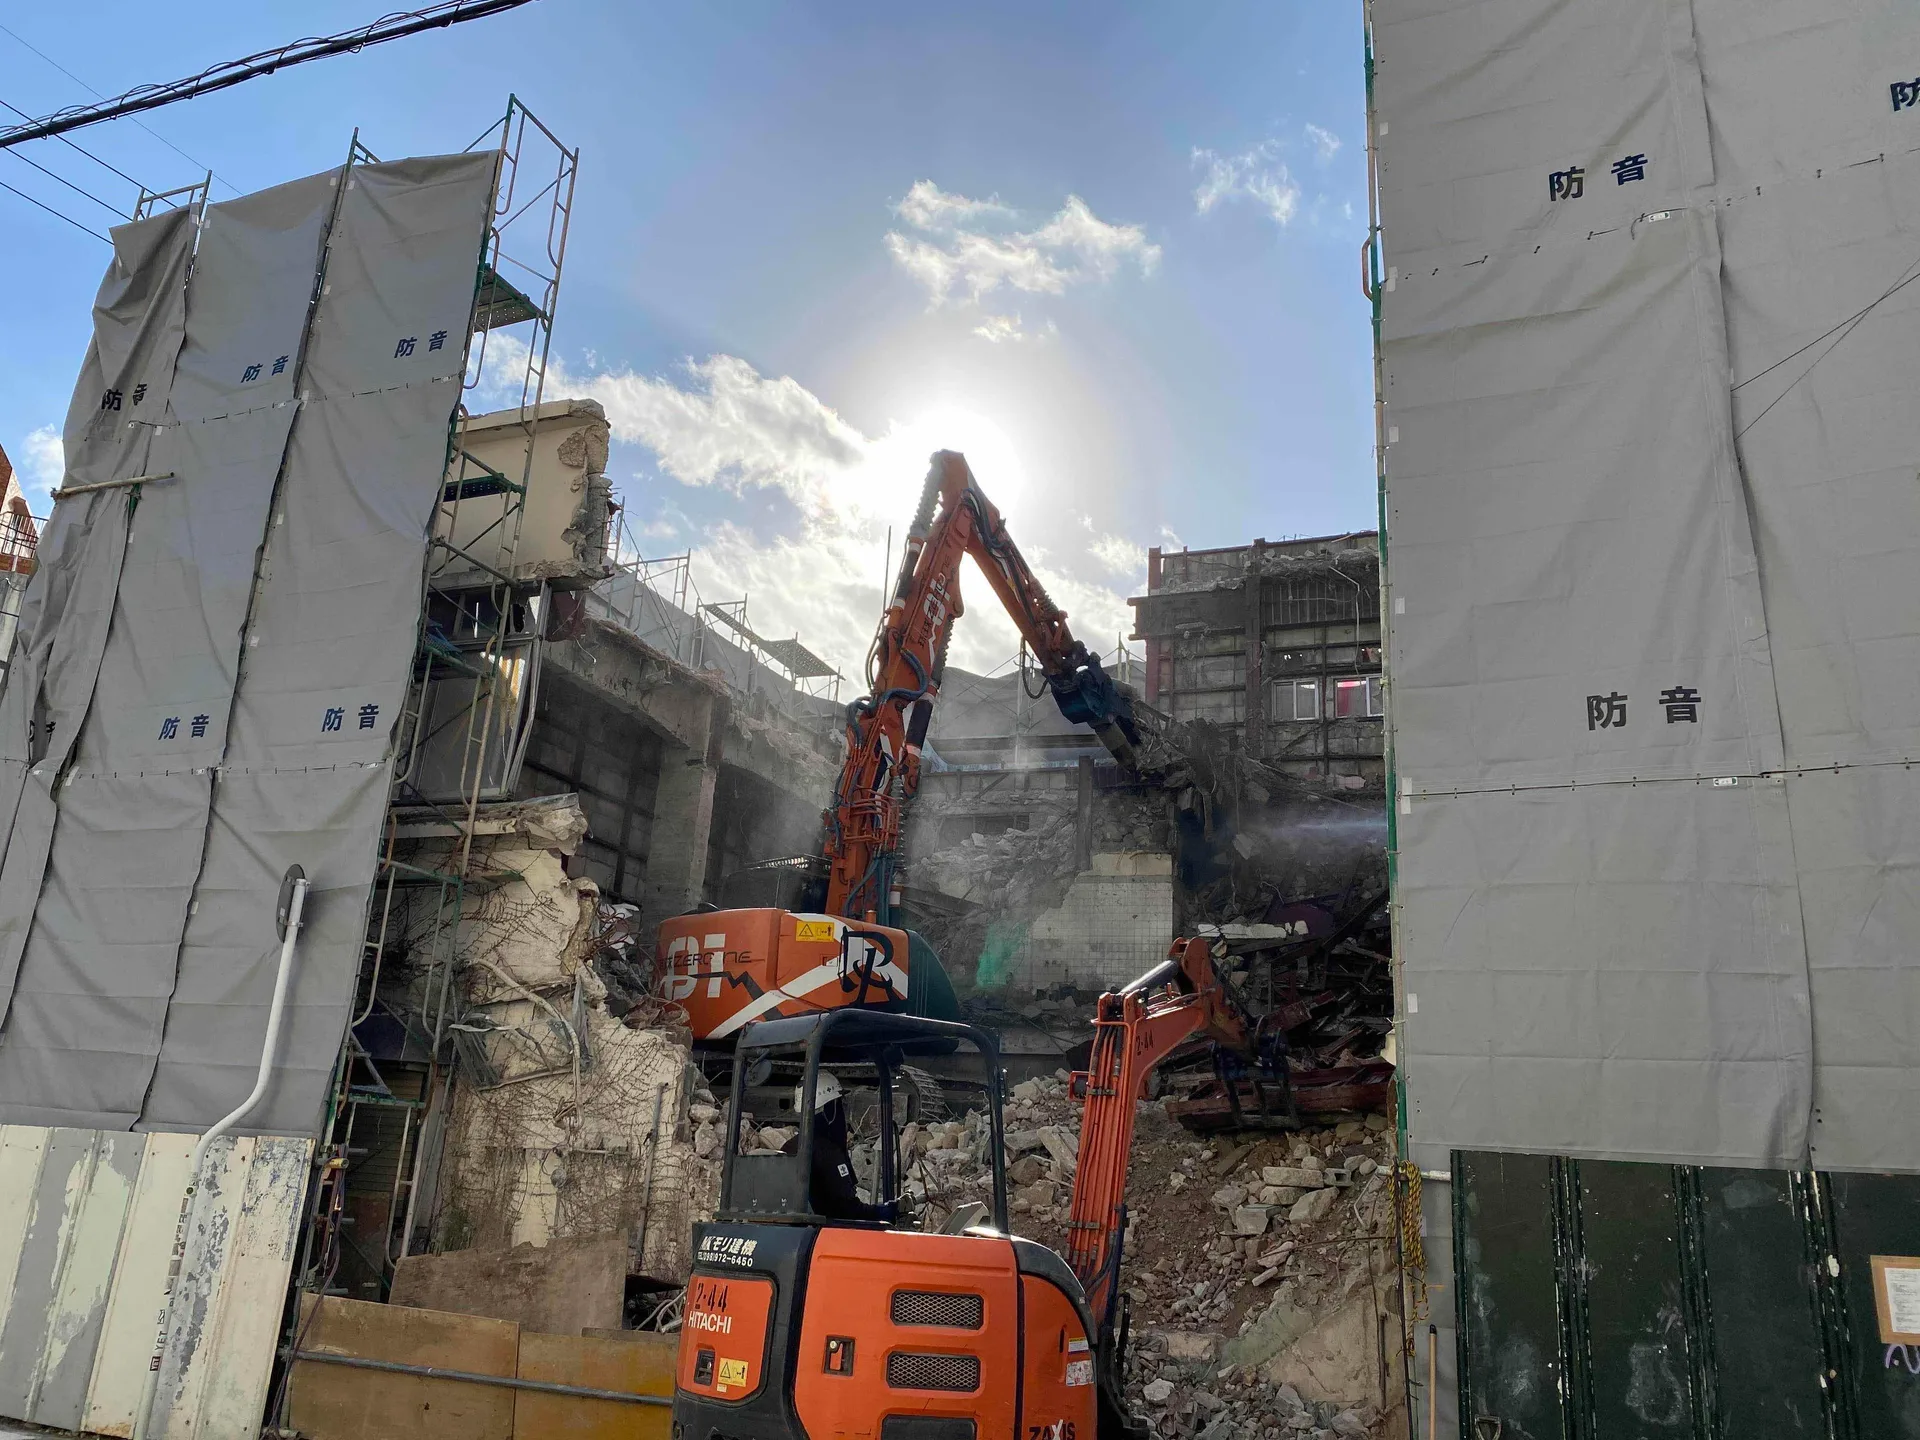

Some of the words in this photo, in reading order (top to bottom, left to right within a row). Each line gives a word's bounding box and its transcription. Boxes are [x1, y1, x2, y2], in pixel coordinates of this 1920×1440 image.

[1549, 154, 1649, 201] 防音
[395, 330, 448, 358] 防音
[241, 355, 289, 383] 防音
[321, 703, 380, 732] 防音
[1586, 686, 1702, 731] 防音
[158, 714, 210, 741] 防音
[688, 1310, 732, 1334] HITACHI
